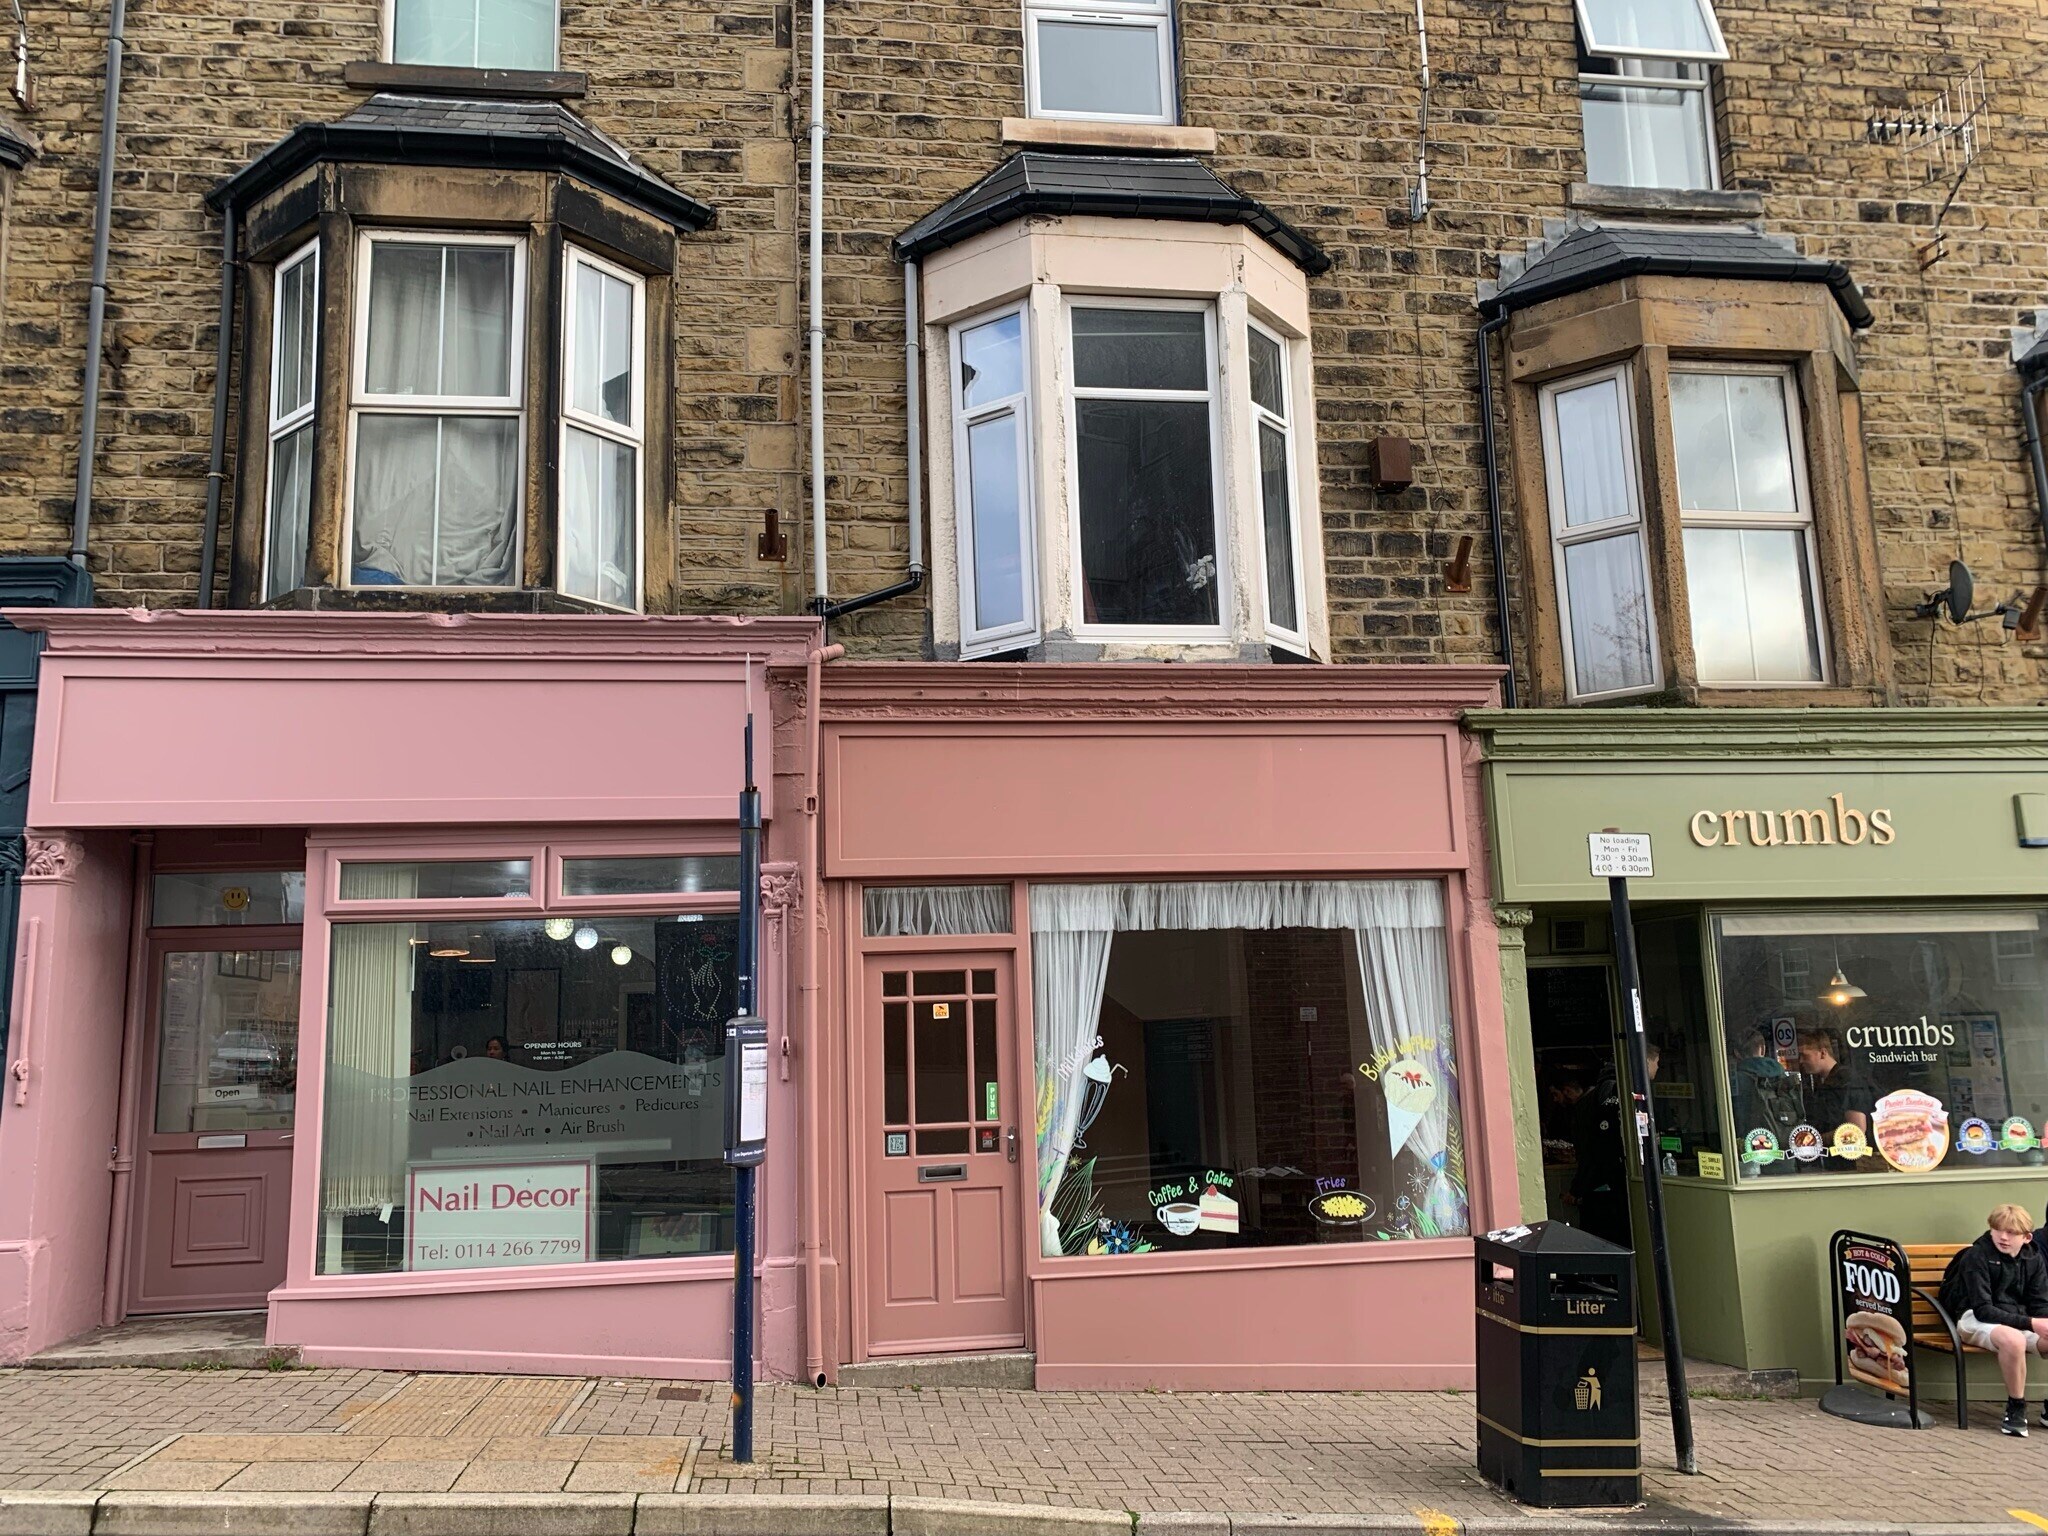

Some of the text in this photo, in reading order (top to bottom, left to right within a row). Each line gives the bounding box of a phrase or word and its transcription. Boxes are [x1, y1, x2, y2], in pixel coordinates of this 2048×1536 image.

[1689, 791, 1896, 848] crumbs
[1613, 837, 1641, 845] loading
[1846, 1015, 1955, 1048] crumbs
[523, 1041, 582, 1050] OPENING HOURS
[1358, 1044, 1397, 1082] Bubble
[1868, 1050, 1938, 1063] Sandwich bar
[215, 1088, 240, 1099] Open
[370, 1073, 721, 1102] PROFESSIONAL NAIL ENHANCEMENTS
[405, 1098, 699, 1123] Nail Extensions Manicures Pedicures
[479, 1119, 625, 1139] Nail Art Air Brush
[1148, 1169, 1234, 1207] Coffee & Cakes
[1315, 1176, 1346, 1196] Fries
[419, 1182, 581, 1213] Nail Decor
[418, 1239, 581, 1260] Tel: 0114 266 7799
[1852, 1249, 1886, 1263] HOT & COLD
[1842, 1260, 1901, 1304] FOOD
[1566, 1300, 1606, 1315] Litter
[1855, 1298, 1893, 1315] served here
